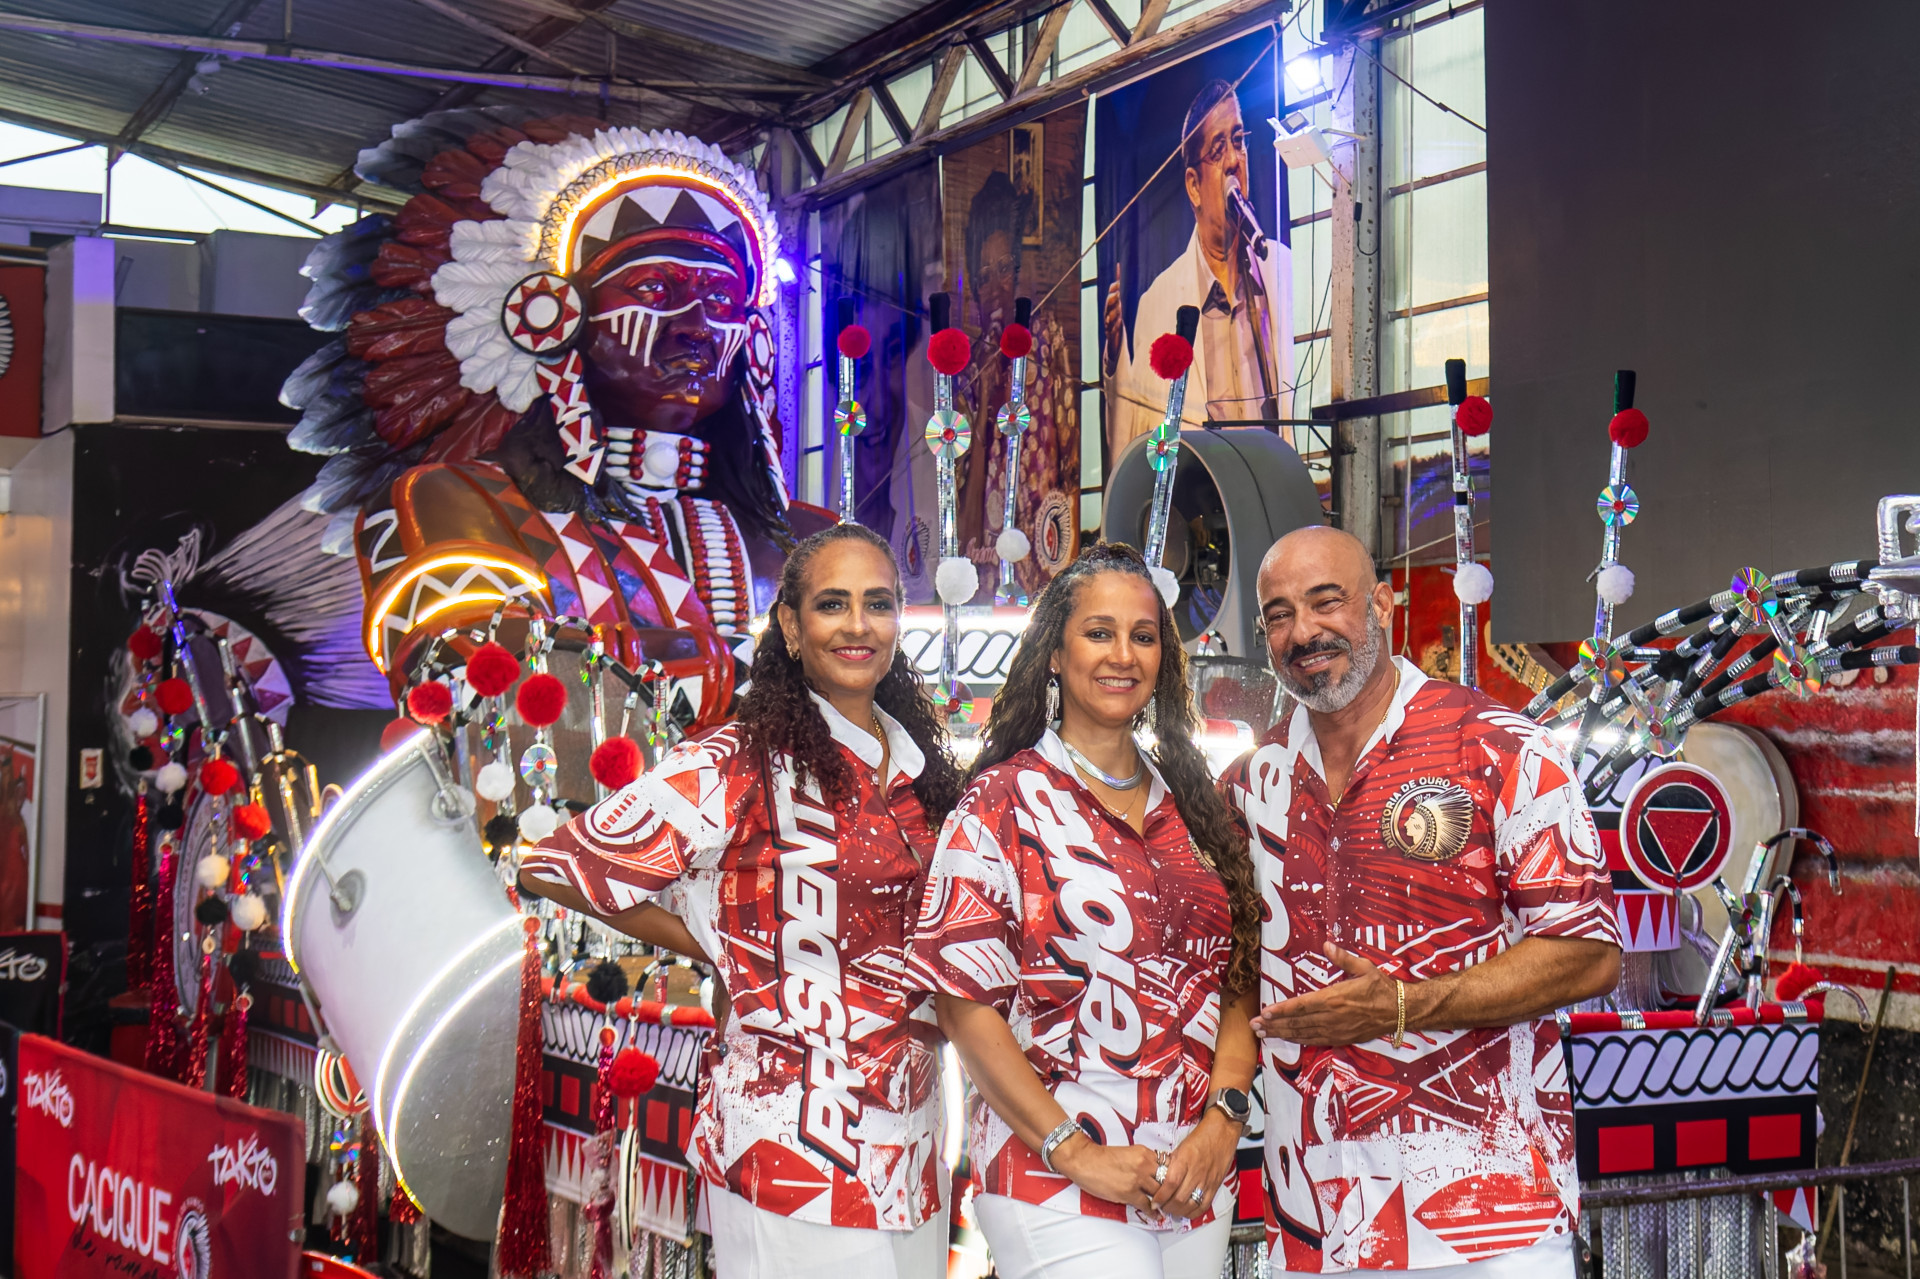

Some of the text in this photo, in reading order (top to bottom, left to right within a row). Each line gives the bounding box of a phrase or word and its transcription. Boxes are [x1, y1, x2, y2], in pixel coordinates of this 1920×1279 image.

[1381, 776, 1451, 849] DIRETORIA DE OURO
[23, 1068, 75, 1128] TAKTO
[207, 1132, 278, 1196] TAKTO
[67, 1152, 173, 1266] CACIQUE
